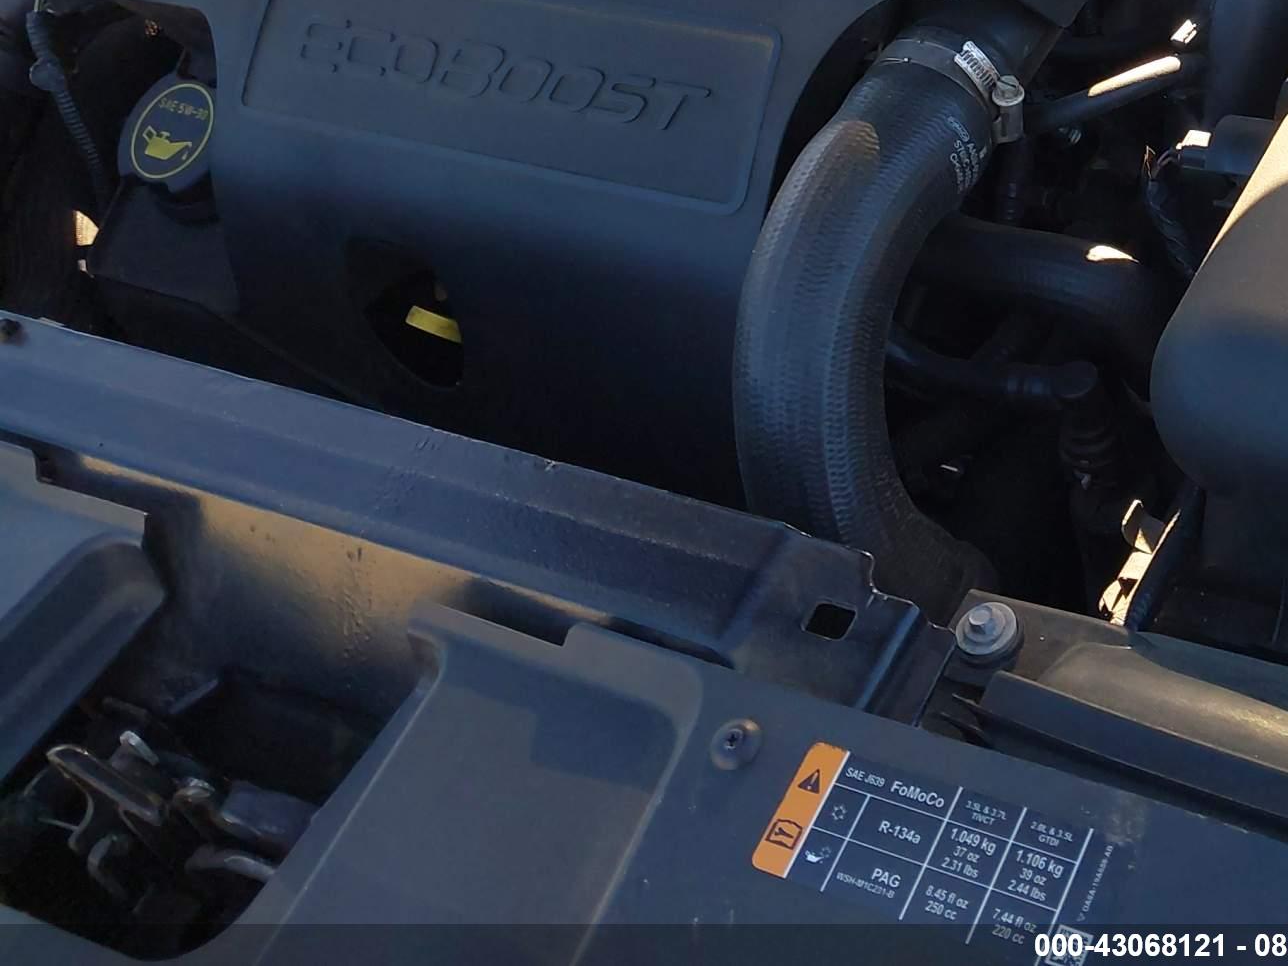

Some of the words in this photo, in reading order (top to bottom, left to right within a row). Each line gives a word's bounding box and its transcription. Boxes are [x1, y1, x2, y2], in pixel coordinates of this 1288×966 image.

[846, 767, 865, 781] SAE
[865, 774, 885, 787] J639
[890, 781, 945, 808] FoMoCo
[878, 820, 921, 844] R-134a
[950, 828, 981, 847] 1.049
[981, 838, 997, 856] kg
[953, 845, 968, 857] 37
[967, 852, 981, 864] oz
[1016, 849, 1047, 870] 1.106
[1047, 860, 1064, 879] kg
[871, 868, 901, 888] PAG
[941, 856, 962, 872] 2.31
[963, 865, 979, 879] lbs
[1019, 867, 1033, 881] 39
[1033, 875, 1047, 886] oz
[925, 884, 948, 901] 8.45
[947, 891, 957, 904] fl
[956, 897, 969, 910] oz
[1008, 880, 1030, 895] 2.44
[1030, 886, 1046, 902] lbs
[925, 899, 945, 915] 250
[944, 908, 957, 921] cc
[992, 908, 1014, 924] 7.44
[1014, 915, 1025, 928] fl
[1024, 921, 1038, 933] oz
[992, 924, 1012, 940] 220
[1012, 932, 1025, 945] cc
